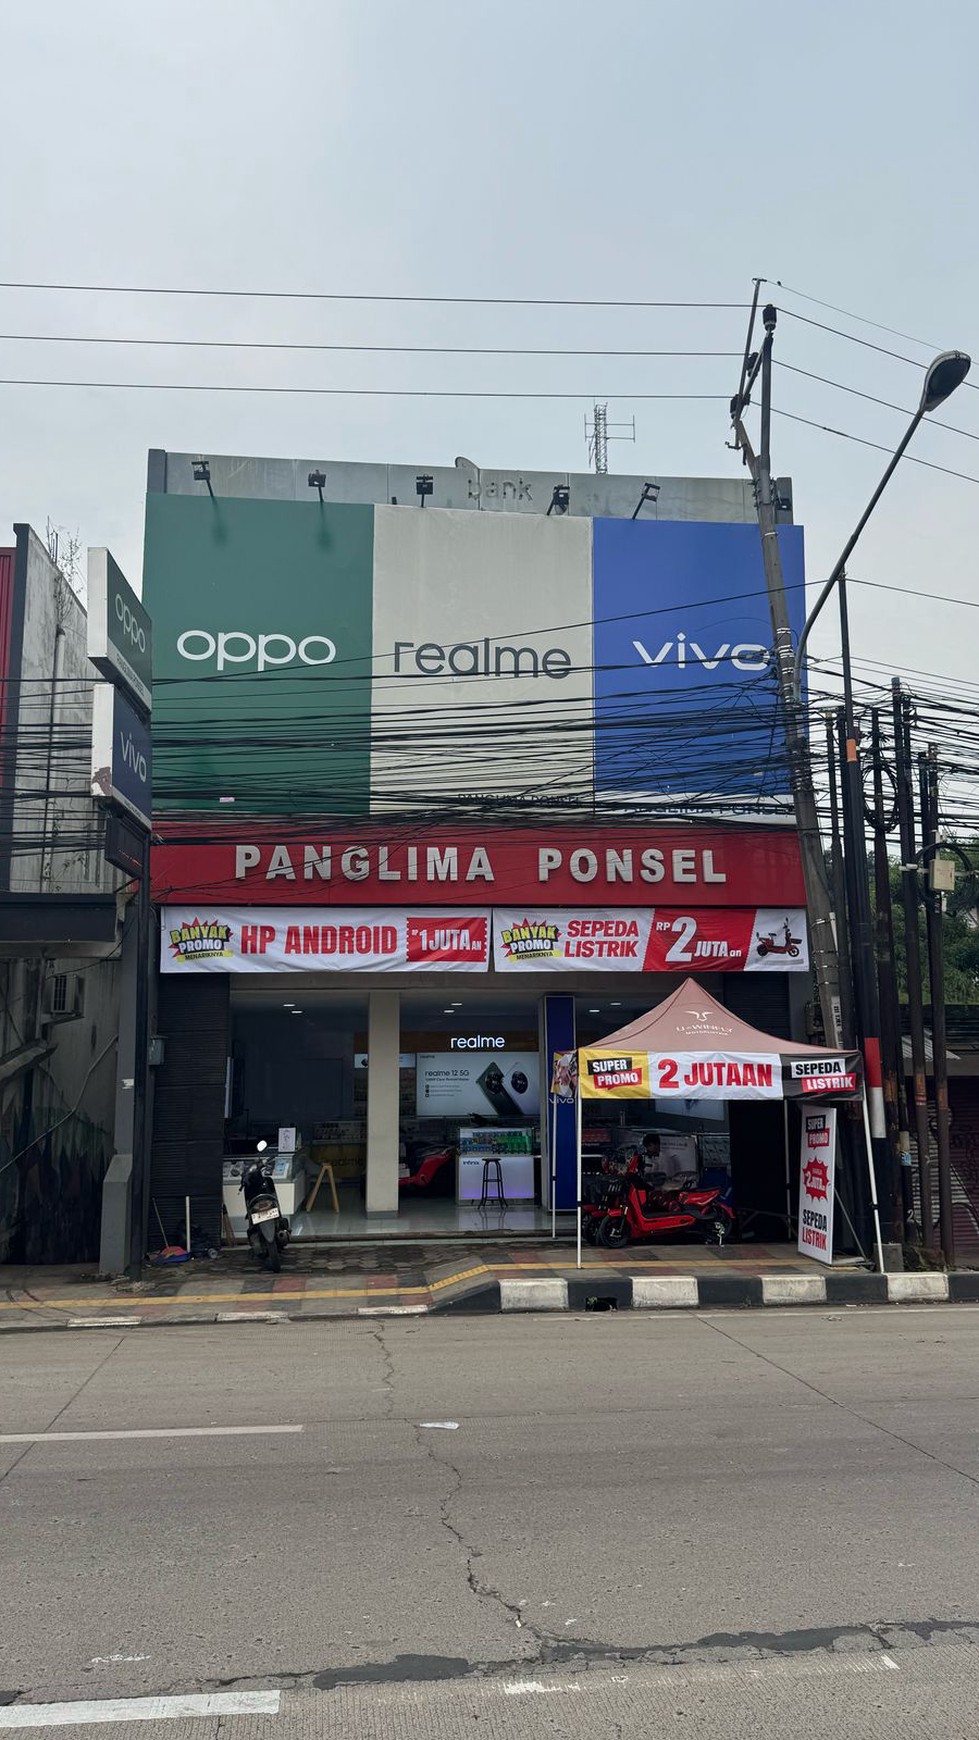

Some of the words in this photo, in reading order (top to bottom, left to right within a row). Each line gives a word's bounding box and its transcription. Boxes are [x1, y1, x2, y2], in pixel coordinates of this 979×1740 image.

[115, 593, 146, 654] oppo
[177, 630, 337, 671] oppo
[394, 637, 571, 679] realme
[633, 632, 770, 671] vivo
[120, 731, 147, 783] vivo
[235, 845, 496, 881] PANGLIMA
[538, 847, 727, 883] PONSEL
[170, 925, 228, 944] BANYAK
[502, 925, 557, 944] BANYAK
[567, 920, 640, 938] SEPEDA
[178, 939, 222, 953] PROMO
[241, 925, 276, 954] HP
[284, 925, 398, 954] ANDROID
[510, 939, 552, 953] PROMO
[656, 921, 671, 931] RP
[665, 916, 697, 962] 2
[184, 951, 224, 961] MENARIKNYA
[516, 951, 554, 961] MENARIKNYA
[564, 940, 638, 958] LISTRIK
[450, 1034, 506, 1049] realme
[592, 1059, 628, 1073] SUPER
[658, 1058, 679, 1088] 2
[684, 1062, 773, 1087] JUTAAN
[795, 1061, 842, 1075] SEPEDA
[597, 1072, 639, 1087] PROMO
[807, 1076, 854, 1090] LISTRIK
[803, 1209, 827, 1231] SEPEDA
[802, 1227, 827, 1250] LISTRIK
